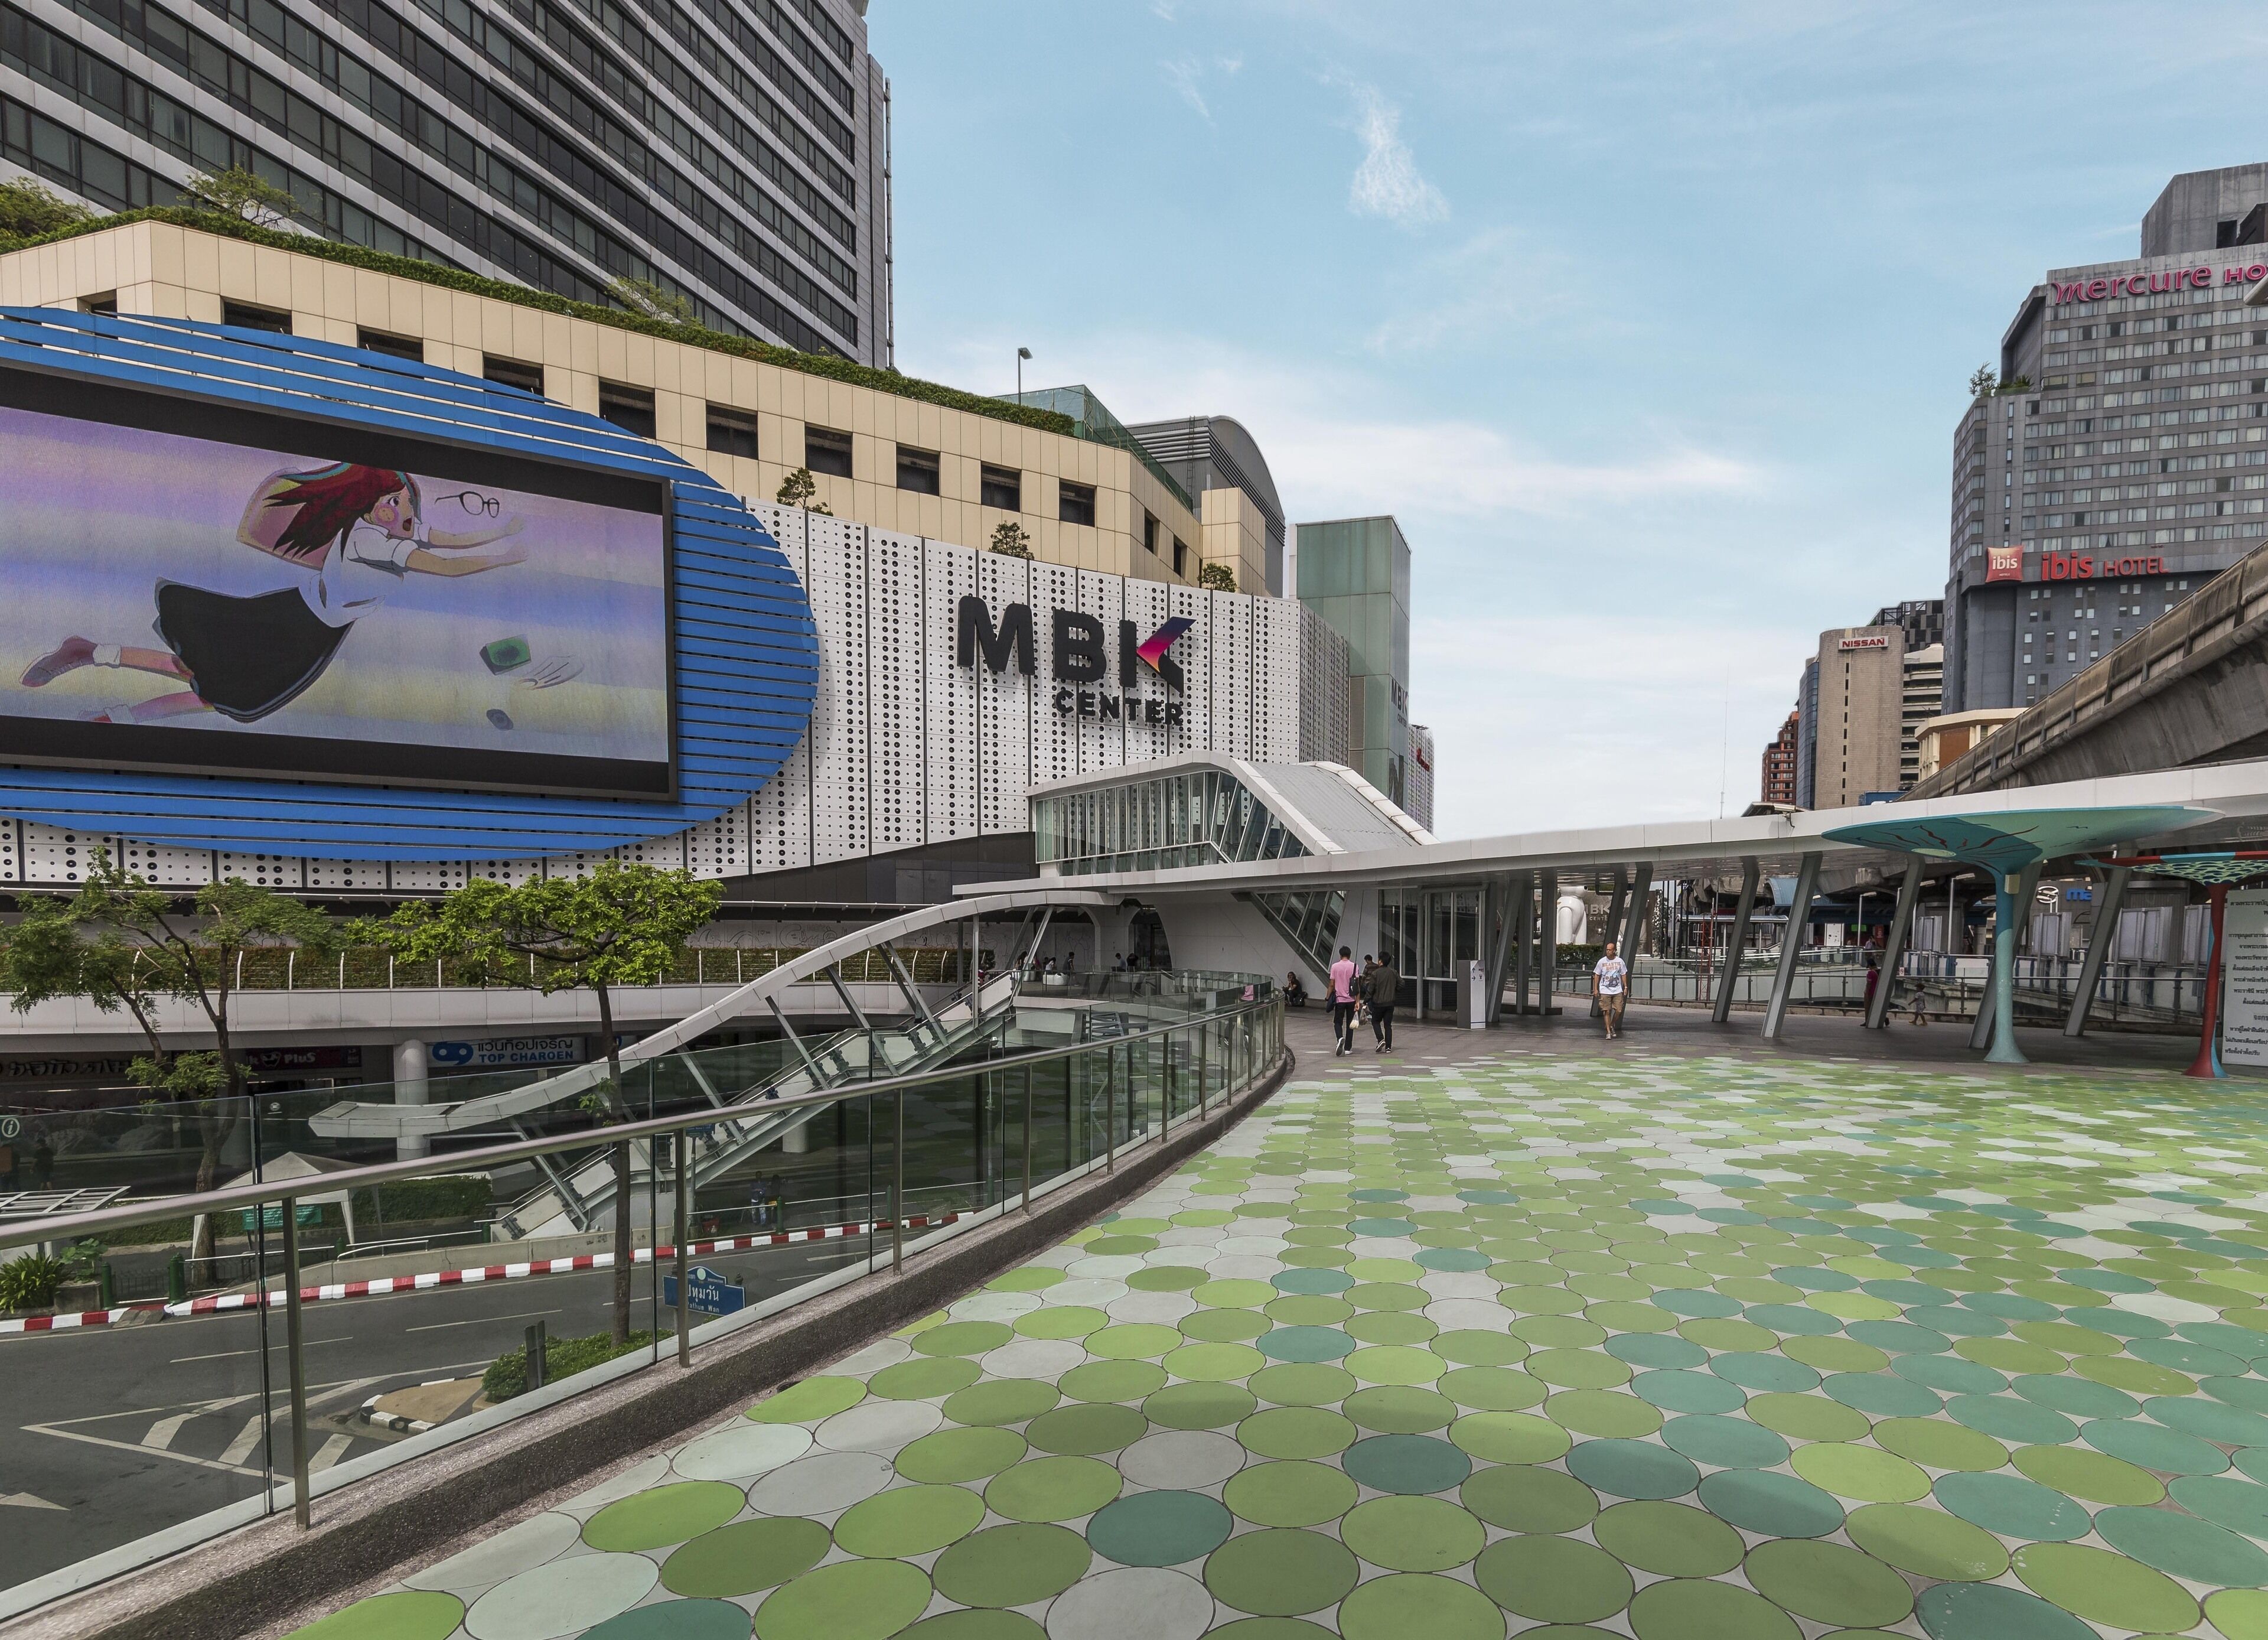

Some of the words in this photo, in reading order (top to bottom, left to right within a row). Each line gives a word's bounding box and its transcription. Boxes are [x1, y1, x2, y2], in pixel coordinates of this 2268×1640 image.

[2051, 266, 2212, 305] mercure
[2224, 264, 2268, 284] HO
[1992, 555, 2018, 570] ibis
[2041, 551, 2094, 581] ibis
[2104, 557, 2169, 577] HOTEL
[957, 595, 1197, 696] MBK
[1842, 637, 1885, 648] NISSAN
[1391, 679, 1409, 717] MBK
[1055, 689, 1184, 726] CENTER
[1397, 713, 1407, 728] CENTER
[2066, 888, 2091, 901] ma
[479, 1053, 504, 1063] TOP
[510, 1050, 573, 1062] CHAROEN
[688, 1302, 705, 1310] athum
[708, 1304, 719, 1313] Wan
